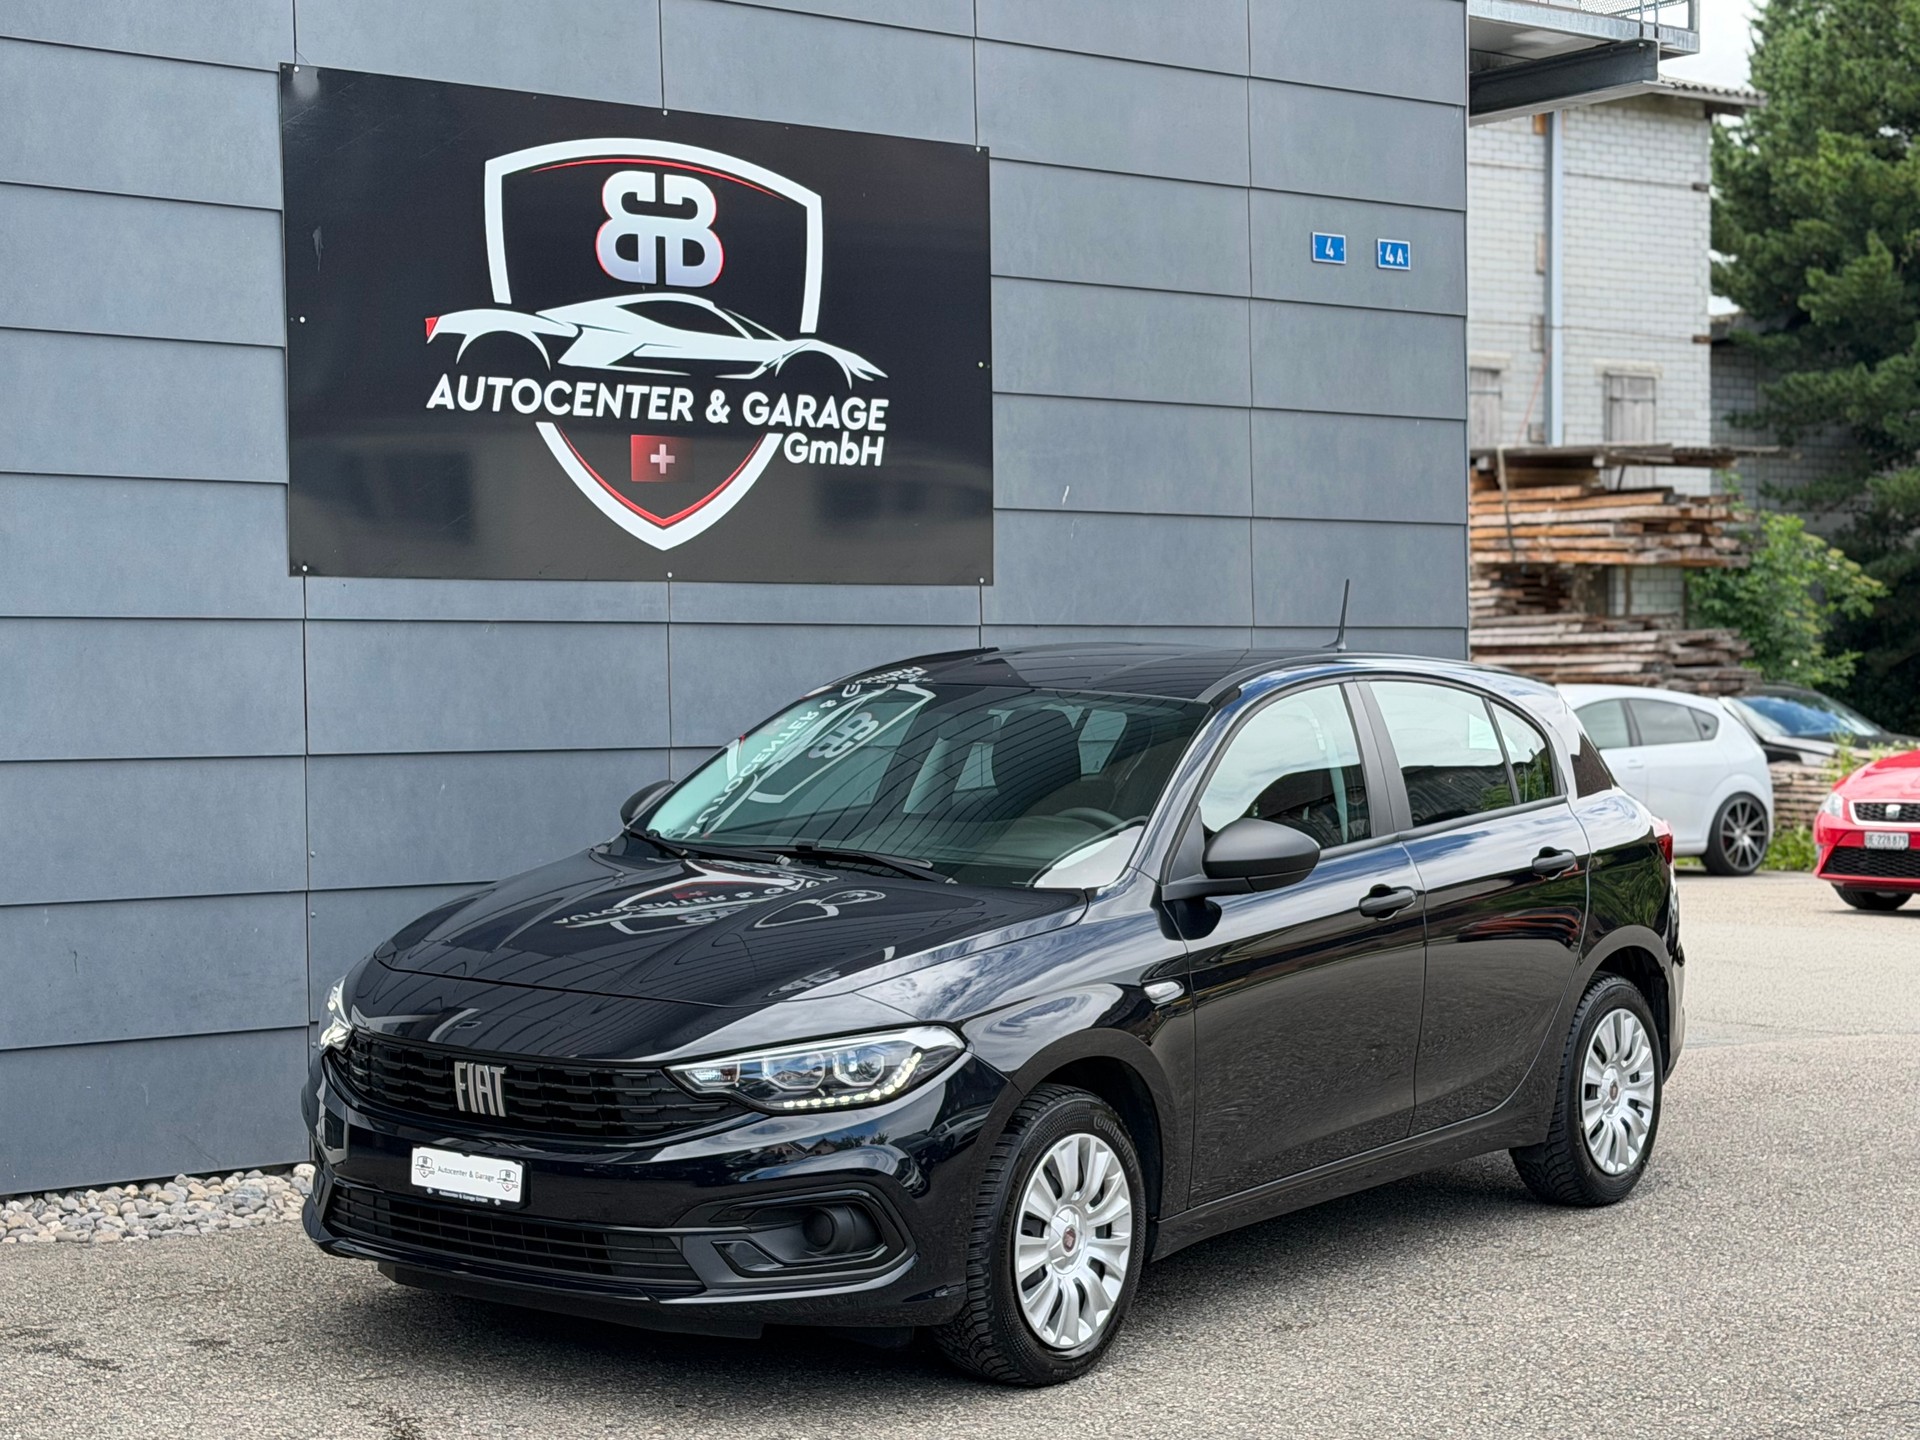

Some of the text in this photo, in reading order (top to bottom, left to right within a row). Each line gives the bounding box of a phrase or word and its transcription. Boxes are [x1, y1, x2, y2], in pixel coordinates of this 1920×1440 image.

[1325, 237, 1335, 258] 4
[1384, 244, 1405, 265] 4A
[426, 373, 891, 432] AUTOCENTER & GARAGE
[783, 430, 886, 468] GmbH
[454, 1061, 507, 1118] FIAT
[437, 1165, 468, 1177] Autocenter
[468, 1170, 474, 1178] &
[474, 1171, 495, 1183] Garage
